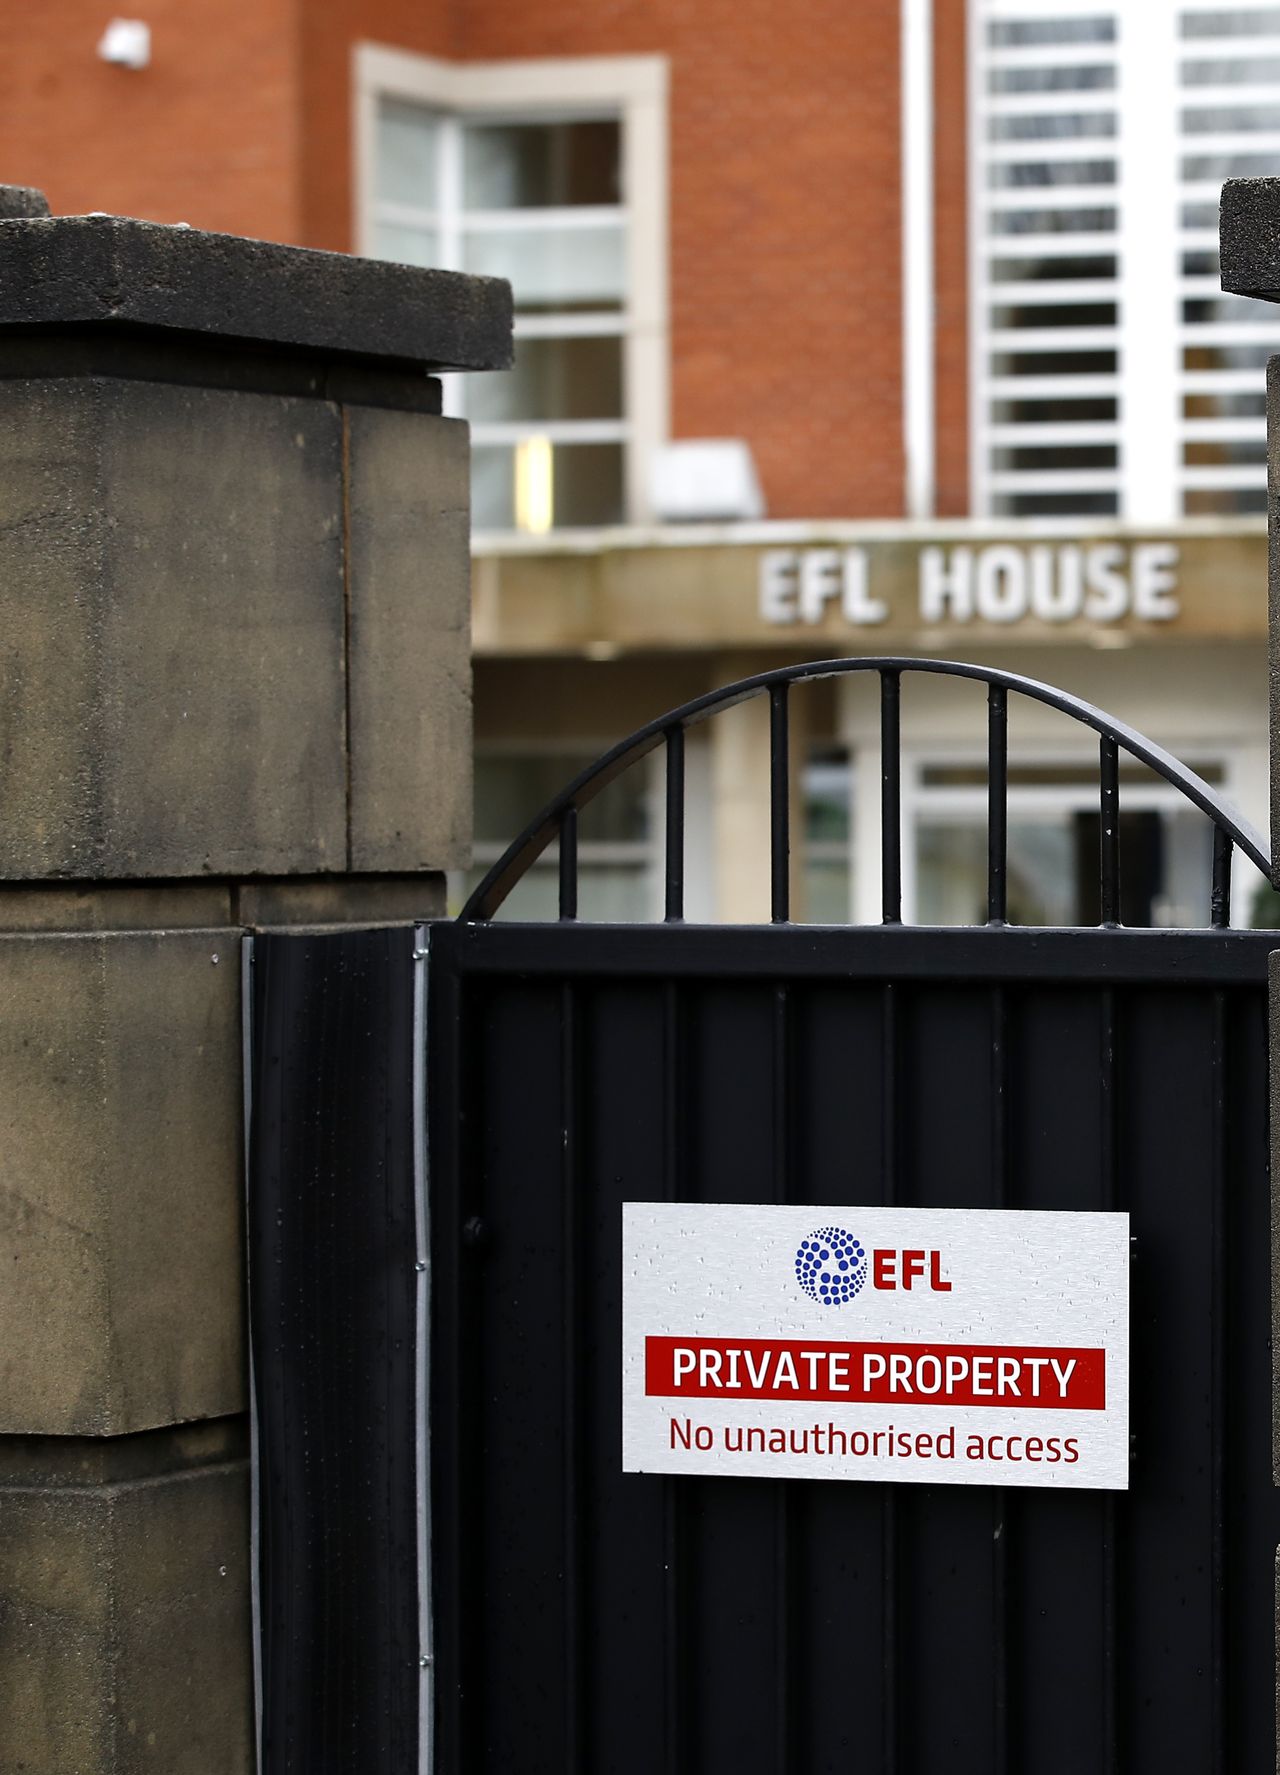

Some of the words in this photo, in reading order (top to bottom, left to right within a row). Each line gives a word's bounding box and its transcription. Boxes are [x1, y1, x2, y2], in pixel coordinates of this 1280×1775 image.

[758, 547, 889, 626] EFL
[918, 542, 1181, 624] HOUSE
[872, 1248, 953, 1293] EFL
[672, 1348, 851, 1392] PRIVATE
[862, 1353, 1077, 1398] PROPERTY
[669, 1418, 714, 1451] No
[724, 1422, 956, 1460] unauthorised
[965, 1434, 1080, 1464] access
